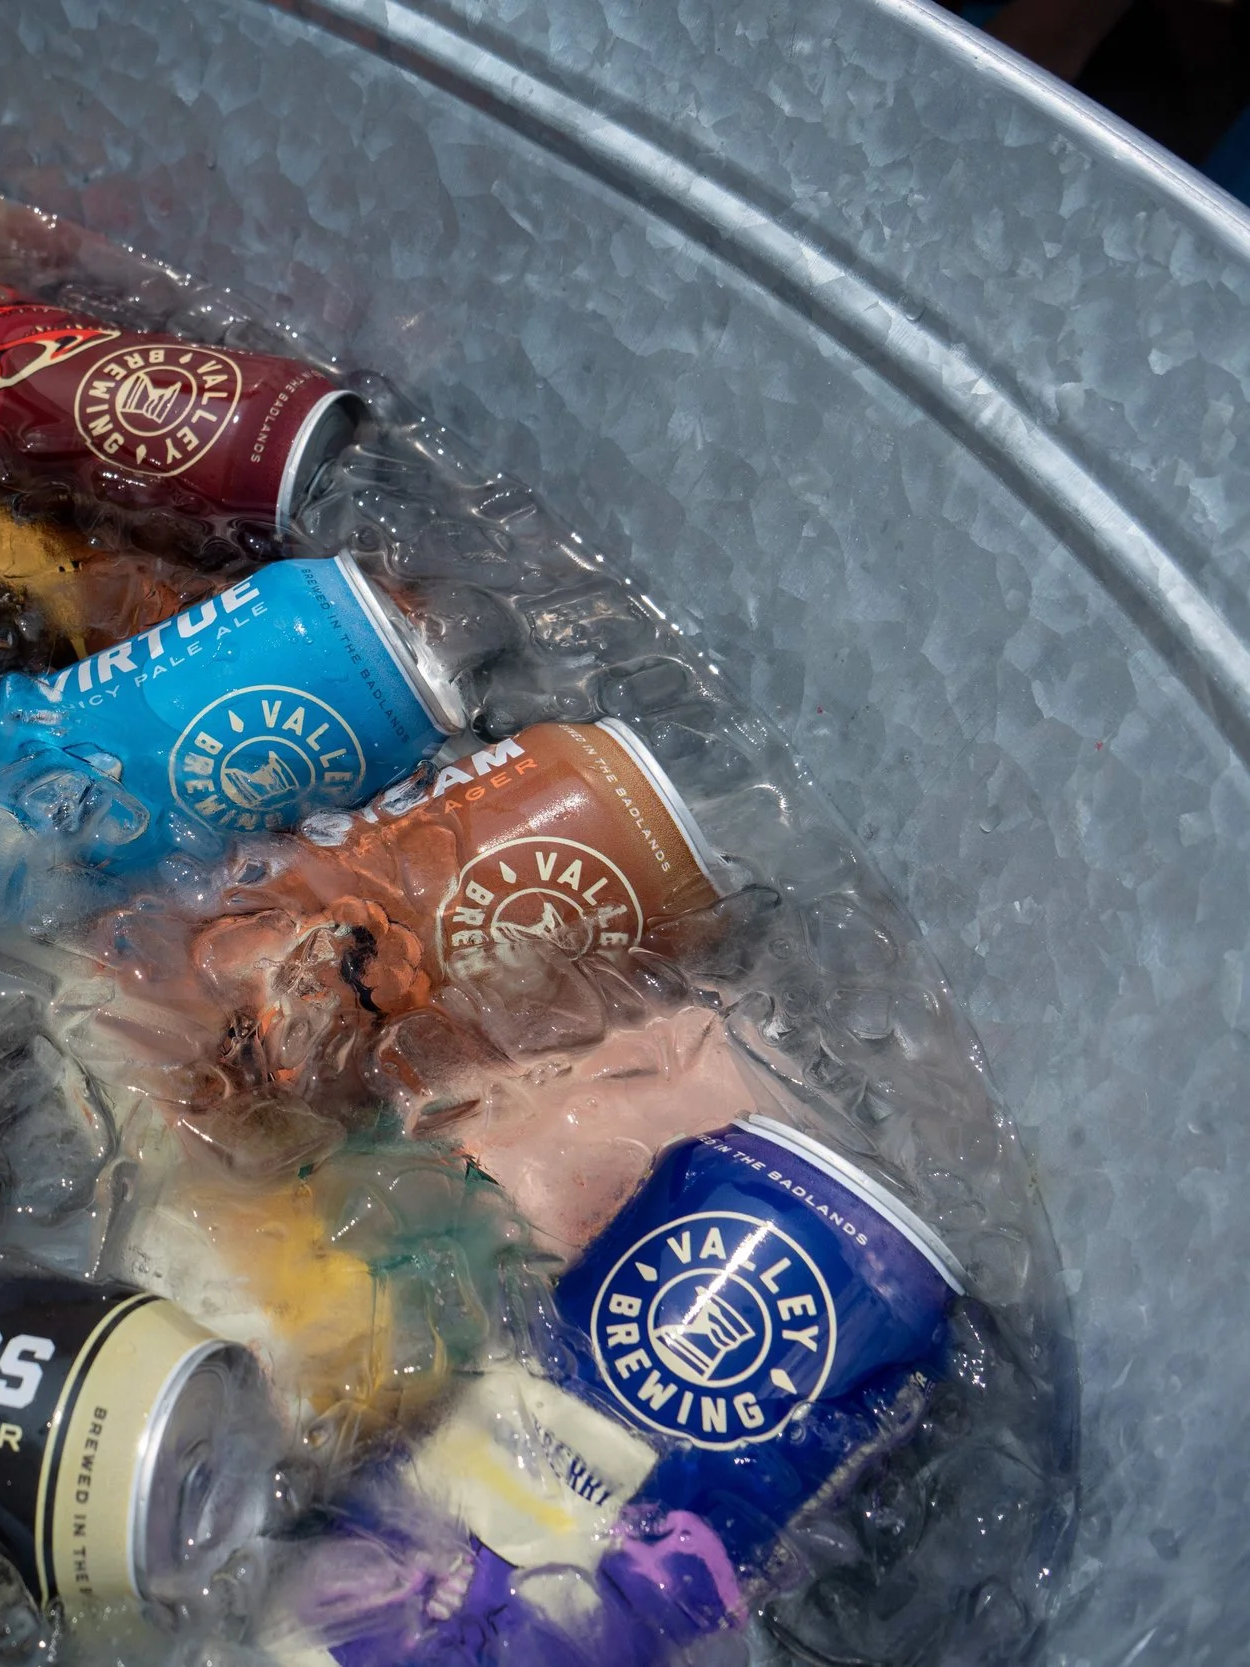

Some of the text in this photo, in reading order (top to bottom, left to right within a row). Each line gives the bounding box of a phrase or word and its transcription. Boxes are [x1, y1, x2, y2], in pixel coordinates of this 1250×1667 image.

[85, 348, 165, 455] BREWING
[165, 359, 229, 465] VALLEY
[250, 392, 290, 464] BADLANDS
[38, 574, 261, 703] VIRTUE
[134, 640, 203, 688] PALE
[216, 601, 268, 640] ALE
[301, 568, 410, 744] BREWED IN THE BADLANDS
[261, 699, 354, 793] VALLE
[444, 757, 538, 815] AGER
[595, 758, 619, 783] THE
[615, 787, 671, 872] BADLANDS
[534, 851, 629, 946] VALLE
[713, 1142, 868, 1246] IN THE BADLANDS
[605, 1293, 766, 1434] BREWING
[75, 1405, 108, 1505] BREWED
[72, 1514, 87, 1538] IN
[73, 1545, 90, 1584] THE
